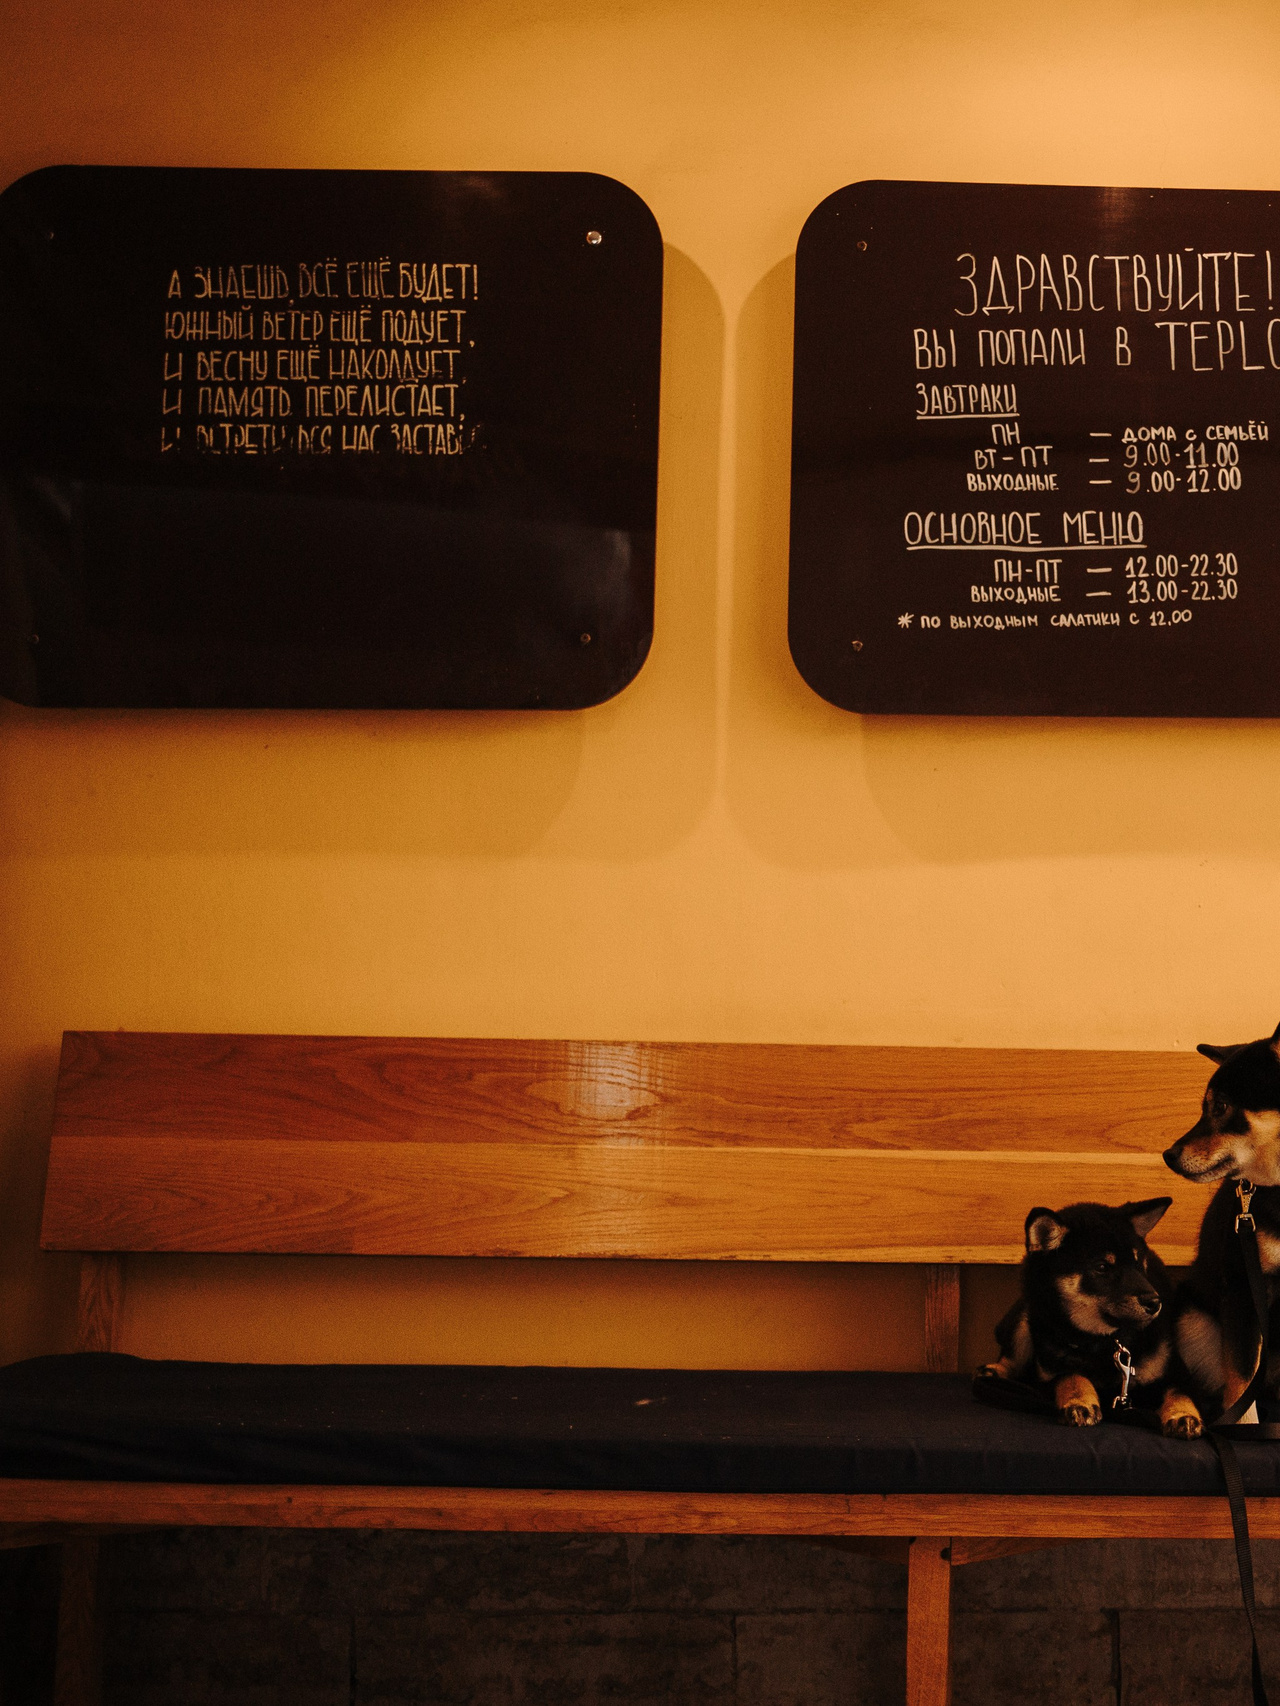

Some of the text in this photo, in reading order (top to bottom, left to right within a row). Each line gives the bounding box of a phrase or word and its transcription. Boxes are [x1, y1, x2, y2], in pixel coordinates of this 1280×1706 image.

[167, 269, 182, 299] А
[299, 257, 339, 299] ВСЁ
[346, 256, 395, 300] ЕЩЁ
[399, 263, 478, 303] БУДЕТ!
[954, 247, 1275, 317] ЗДРАВСТВУЙТЕ!
[164, 303, 254, 341] ЮЖНЫЙ
[261, 309, 324, 341] ВЕТЕР
[381, 309, 476, 348] ПОДУЕТ,
[164, 352, 183, 381] И
[196, 349, 268, 382] ВЕСНУ
[276, 344, 321, 383] ЕЩЁ
[913, 328, 957, 370] ВЫ
[978, 328, 1087, 367] ПОПАЛИ
[1115, 326, 1132, 366] В
[162, 383, 465, 422] И ПАМЯТЬ ПЕРЕЛИСТАЕТ,
[915, 383, 1019, 415] ЗАВТРАКИ
[197, 423, 332, 455] ВСТРЕТИЬСЯ
[341, 425, 380, 452] НАС
[991, 422, 1021, 445] ПН
[1121, 425, 1177, 444] ДОМА
[966, 472, 1059, 492] ВЫХОДНЫЕ
[903, 510, 1145, 546] ОСНОВНОЕ МЕНЮ
[1124, 552, 1239, 580] 12.00-22.30
[970, 585, 1062, 603] ВЫХОДНЫЕ
[920, 614, 942, 629] ПО
[949, 613, 1039, 630] ВЫХОДНЫМ
[1049, 613, 1121, 629] САЛАТИКИ
